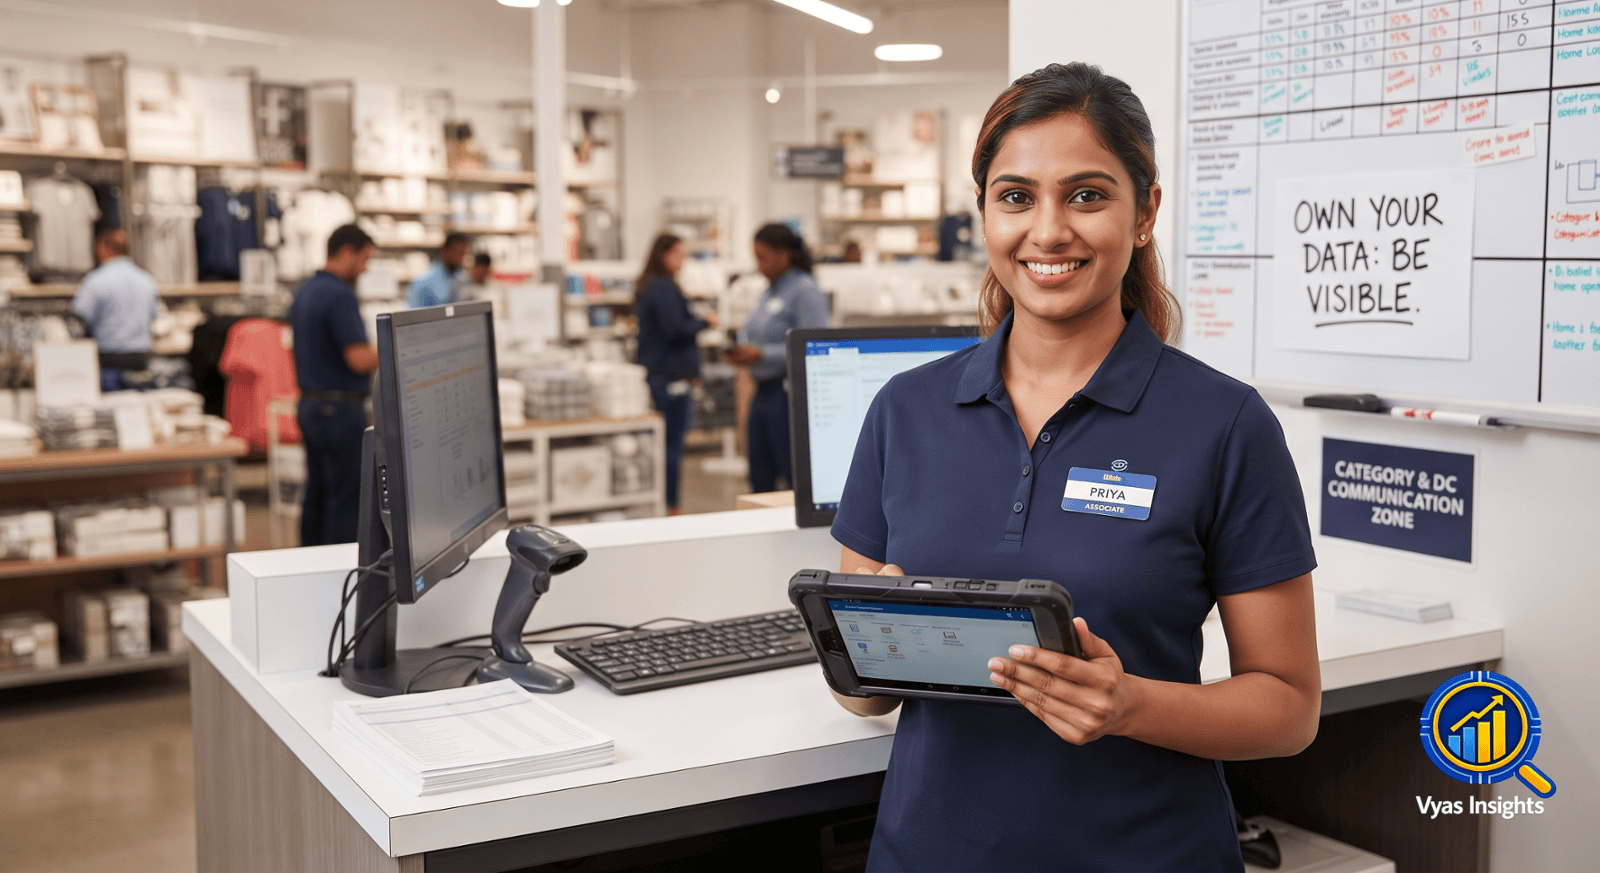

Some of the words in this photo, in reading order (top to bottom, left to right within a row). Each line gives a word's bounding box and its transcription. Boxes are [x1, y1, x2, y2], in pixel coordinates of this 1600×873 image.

[1557, 28, 1584, 41] Home
[1556, 48, 1583, 61] Home
[1294, 197, 1355, 234] OWN
[1368, 192, 1444, 231] YOUR
[1303, 240, 1379, 273] DATA:
[1392, 237, 1430, 272] BE
[1306, 281, 1420, 314] VISIBLE.
[1552, 320, 1576, 334] Home
[1335, 460, 1416, 488] CATEGORY
[1417, 471, 1431, 490] &
[1432, 473, 1458, 494] DC
[1089, 487, 1126, 501] PRIYA
[1327, 479, 1465, 517] COMMUNICATION
[1084, 503, 1126, 514] ASSOCIATE
[1370, 506, 1415, 530] ZONE
